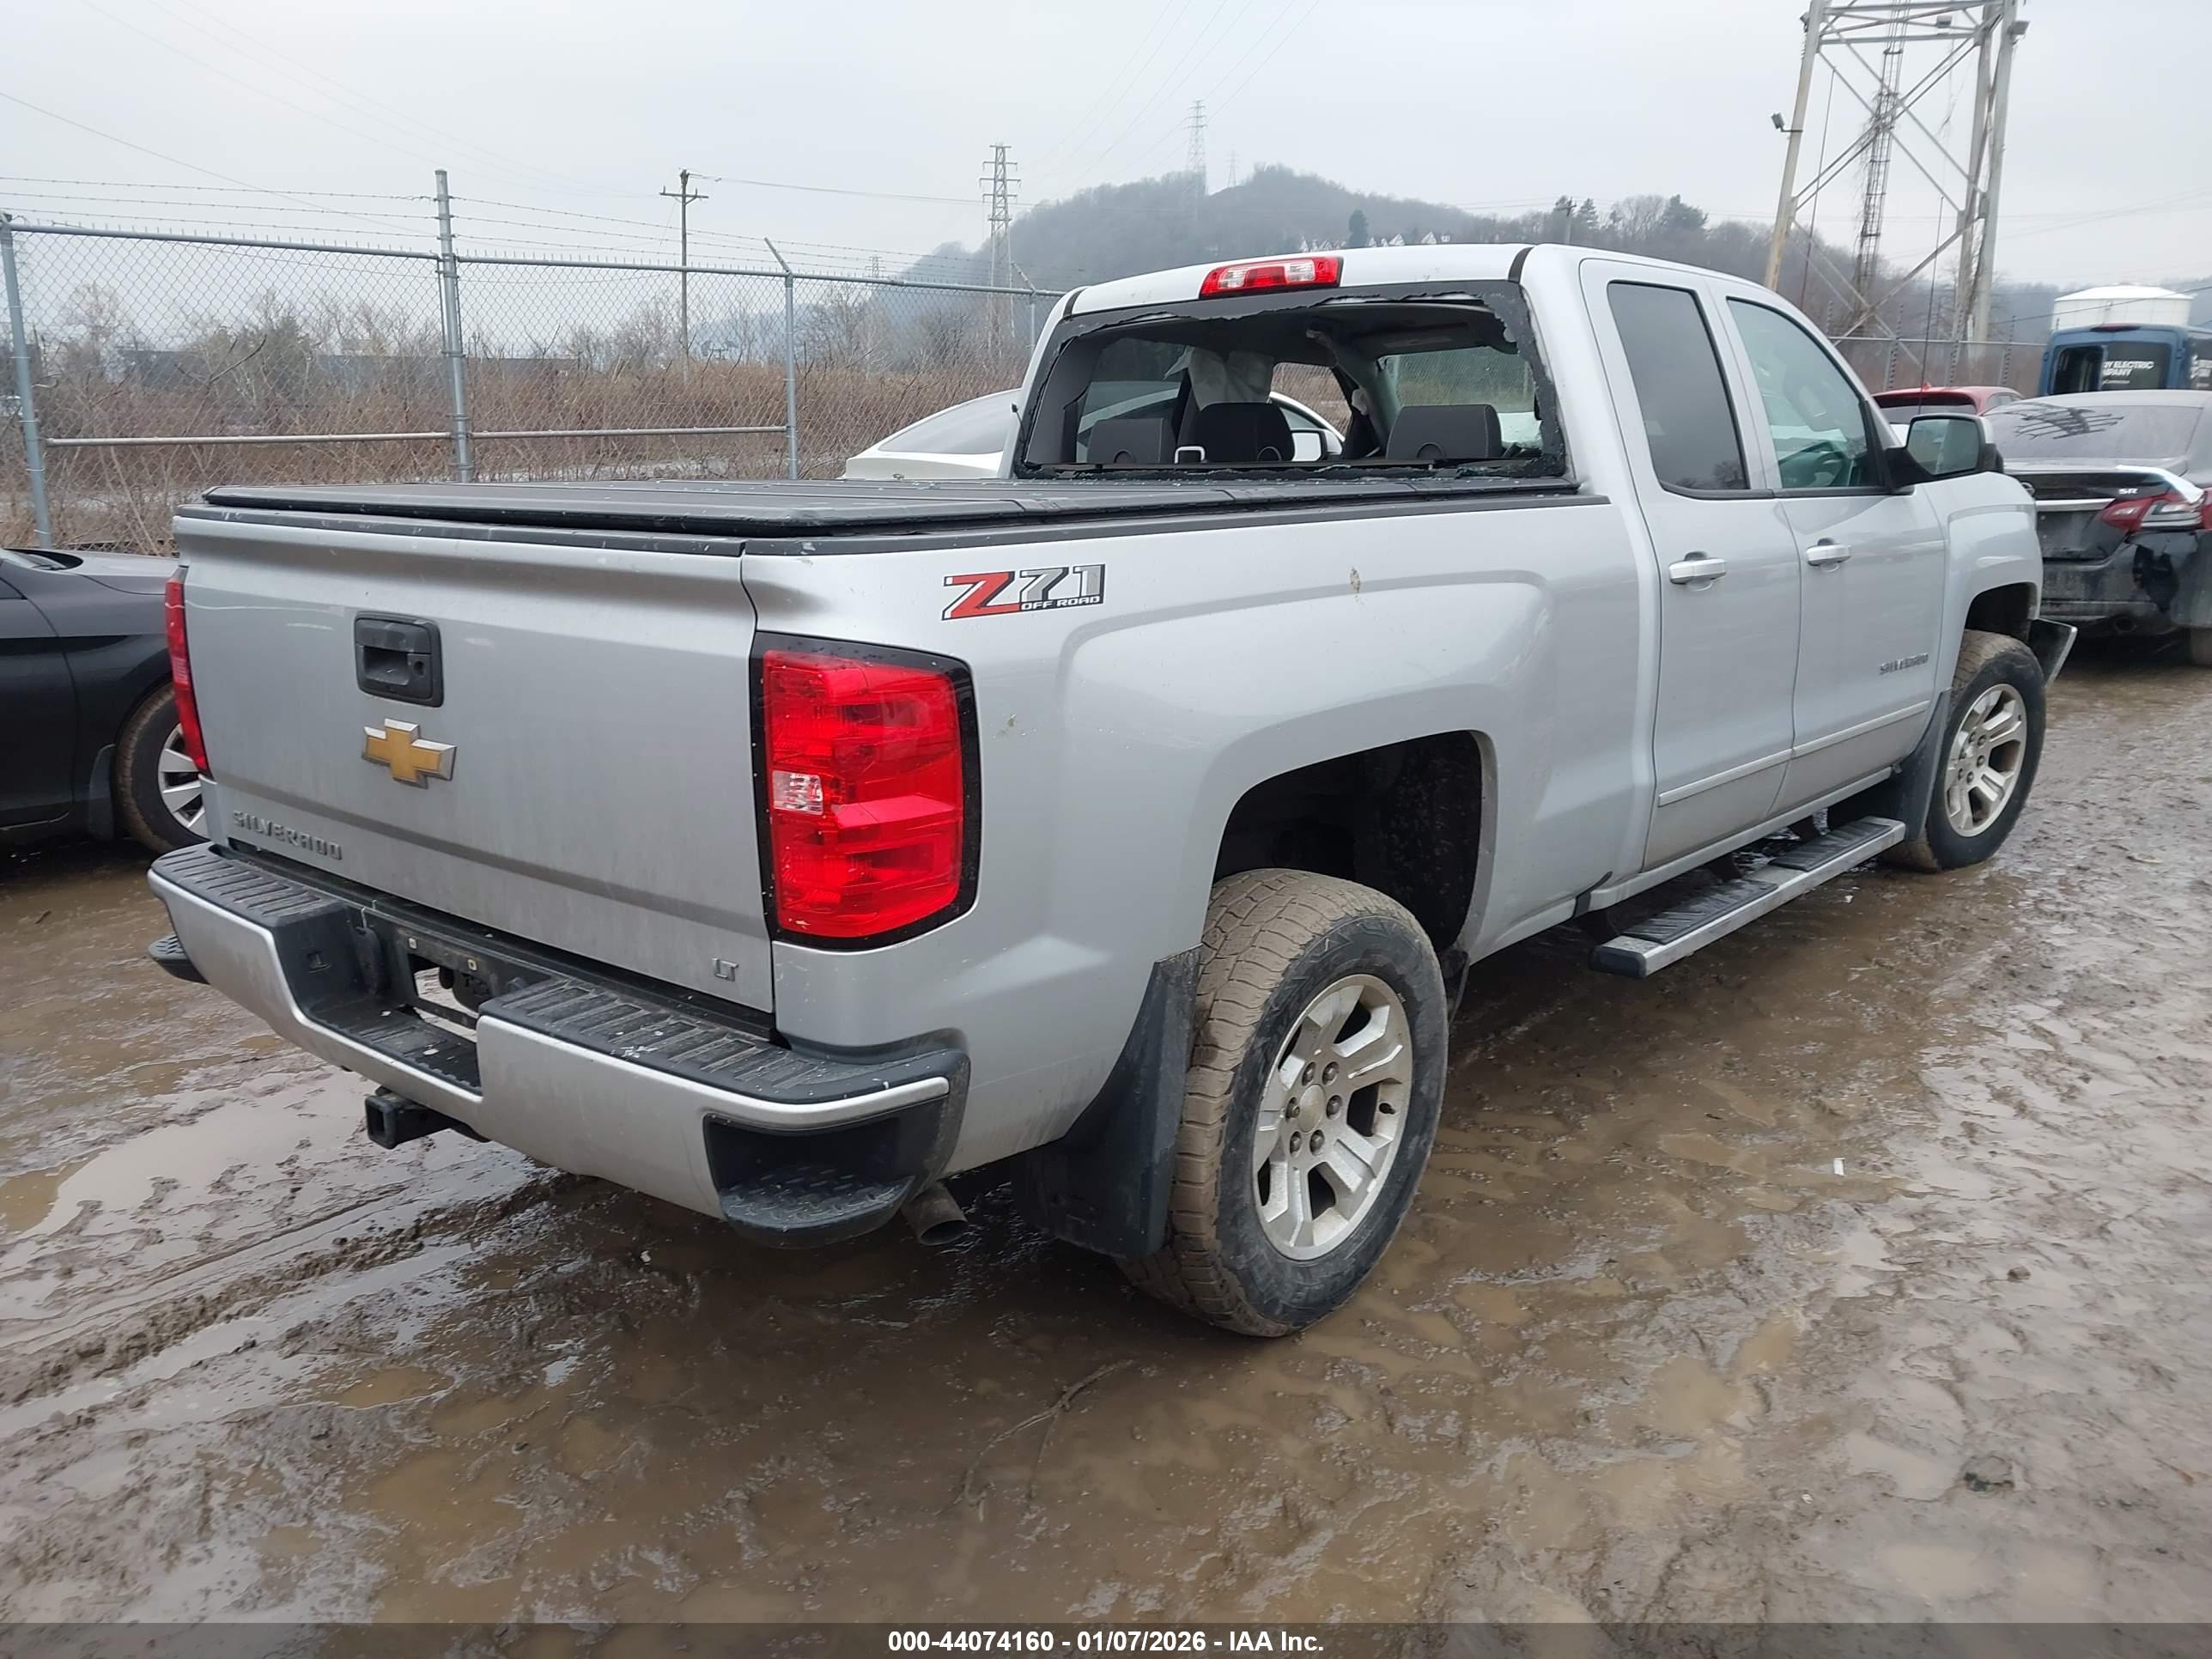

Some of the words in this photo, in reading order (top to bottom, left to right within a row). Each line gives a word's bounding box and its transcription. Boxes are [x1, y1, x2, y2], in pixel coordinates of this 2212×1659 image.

[2113, 361, 2154, 370] ELECTRIC
[941, 564, 1105, 620] Z71
[1021, 602, 1052, 611] OFF
[1057, 595, 1099, 607] ROAD
[233, 810, 343, 860] SILVERADO
[712, 956, 739, 981] LT
